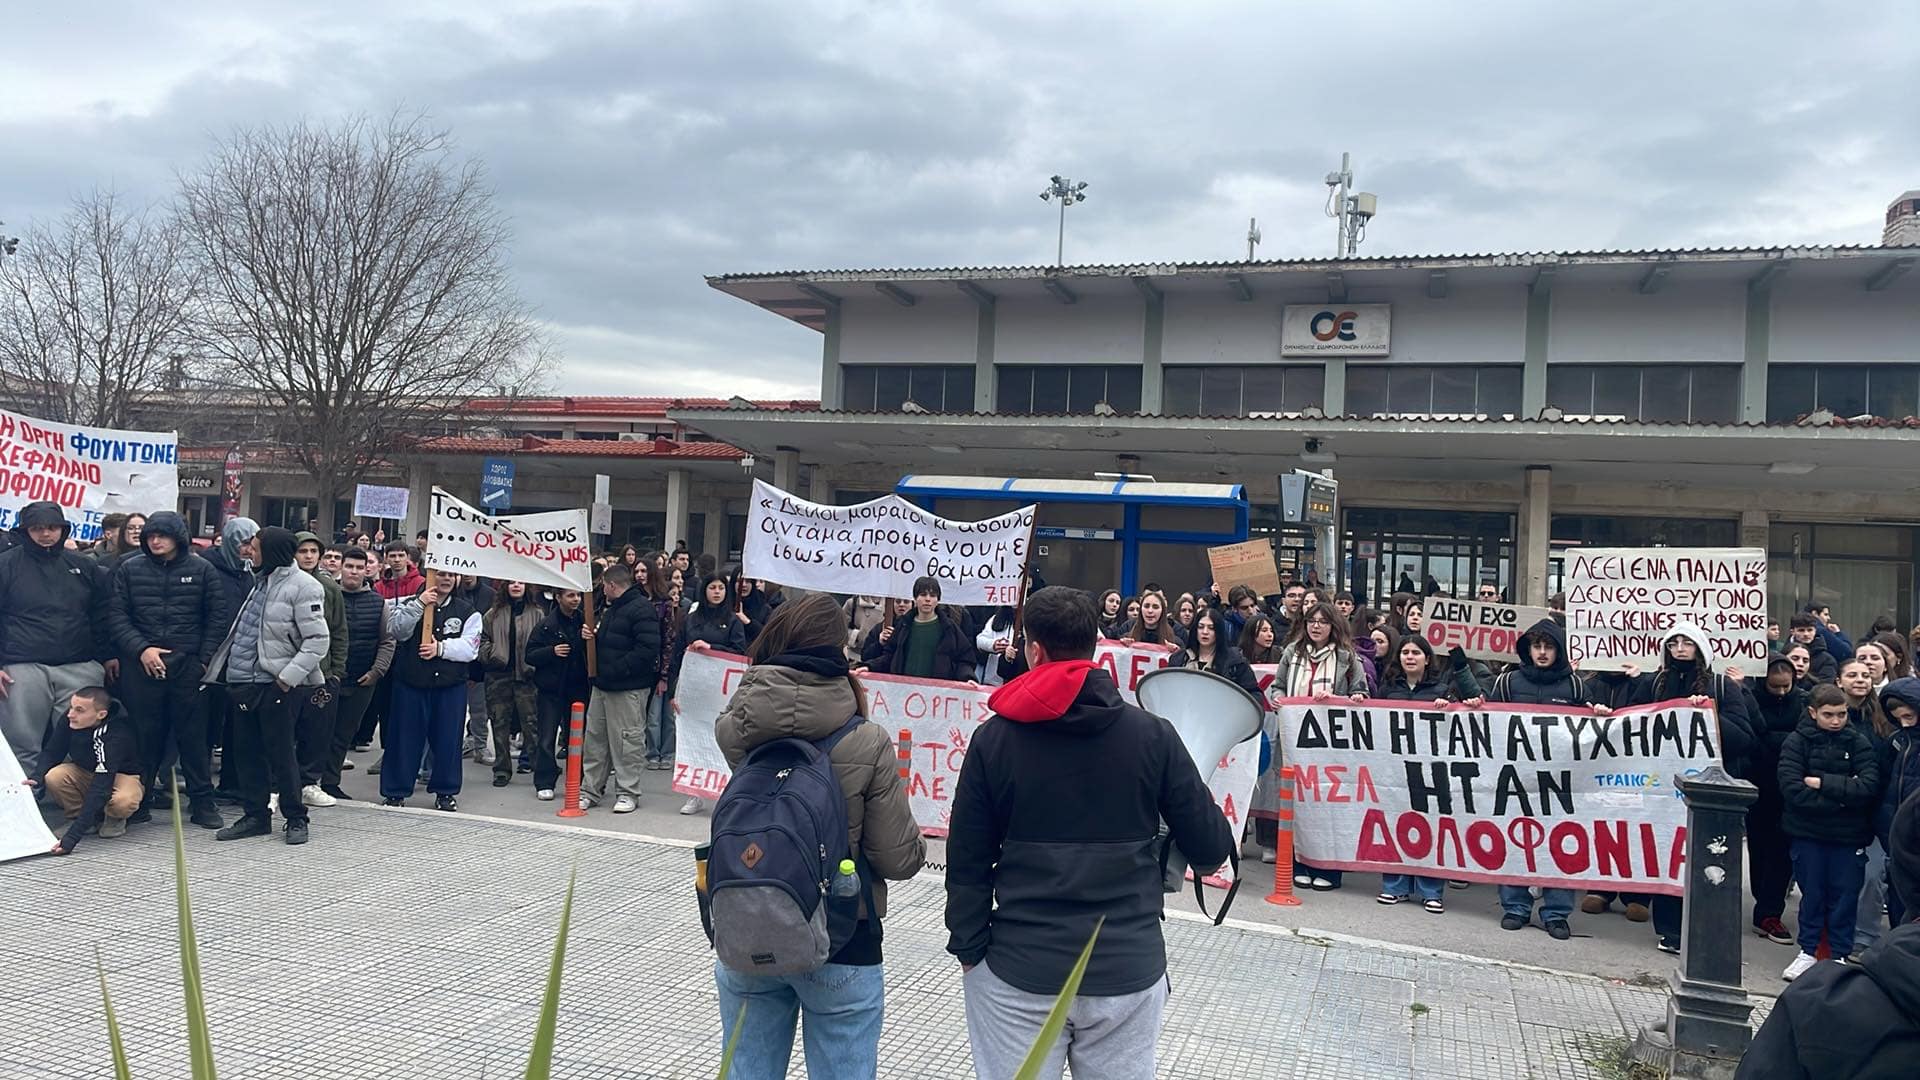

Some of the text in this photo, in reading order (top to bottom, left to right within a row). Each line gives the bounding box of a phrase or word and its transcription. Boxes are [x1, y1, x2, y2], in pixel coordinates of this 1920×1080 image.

[20, 421, 64, 452] ΟΡΓΗ
[0, 468, 86, 509] ΟΦΟΝΟΙ
[445, 555, 477, 568] ΕΠΑΛ
[559, 545, 588, 571] μας
[840, 547, 915, 574] κάποιο
[1571, 555, 1740, 584] ΛΕΕΙ ΕΝΑ ΠΑΙΔΙ
[1568, 585, 1764, 611] ΔΕΝ ΕΧΩ ΟΞΥΓΟΝΟ
[1430, 601, 1517, 627] ΔΕΝ ΕΧΩ
[1575, 609, 1607, 629] ΓΙΑ
[1609, 610, 1677, 632] ΕΚΕΙΝΕΣ
[1714, 611, 1765, 632] ΦΩΝΕΣ
[1427, 622, 1523, 654] ΟΞΥΓΟΝ
[1708, 637, 1767, 660] ΡΟΜΟ
[1296, 709, 1715, 762] ΔΕΝ ΗΤΑΝ ΑΤΥΧΗΜΑ
[1404, 760, 1572, 816] ΗΤΑΝ
